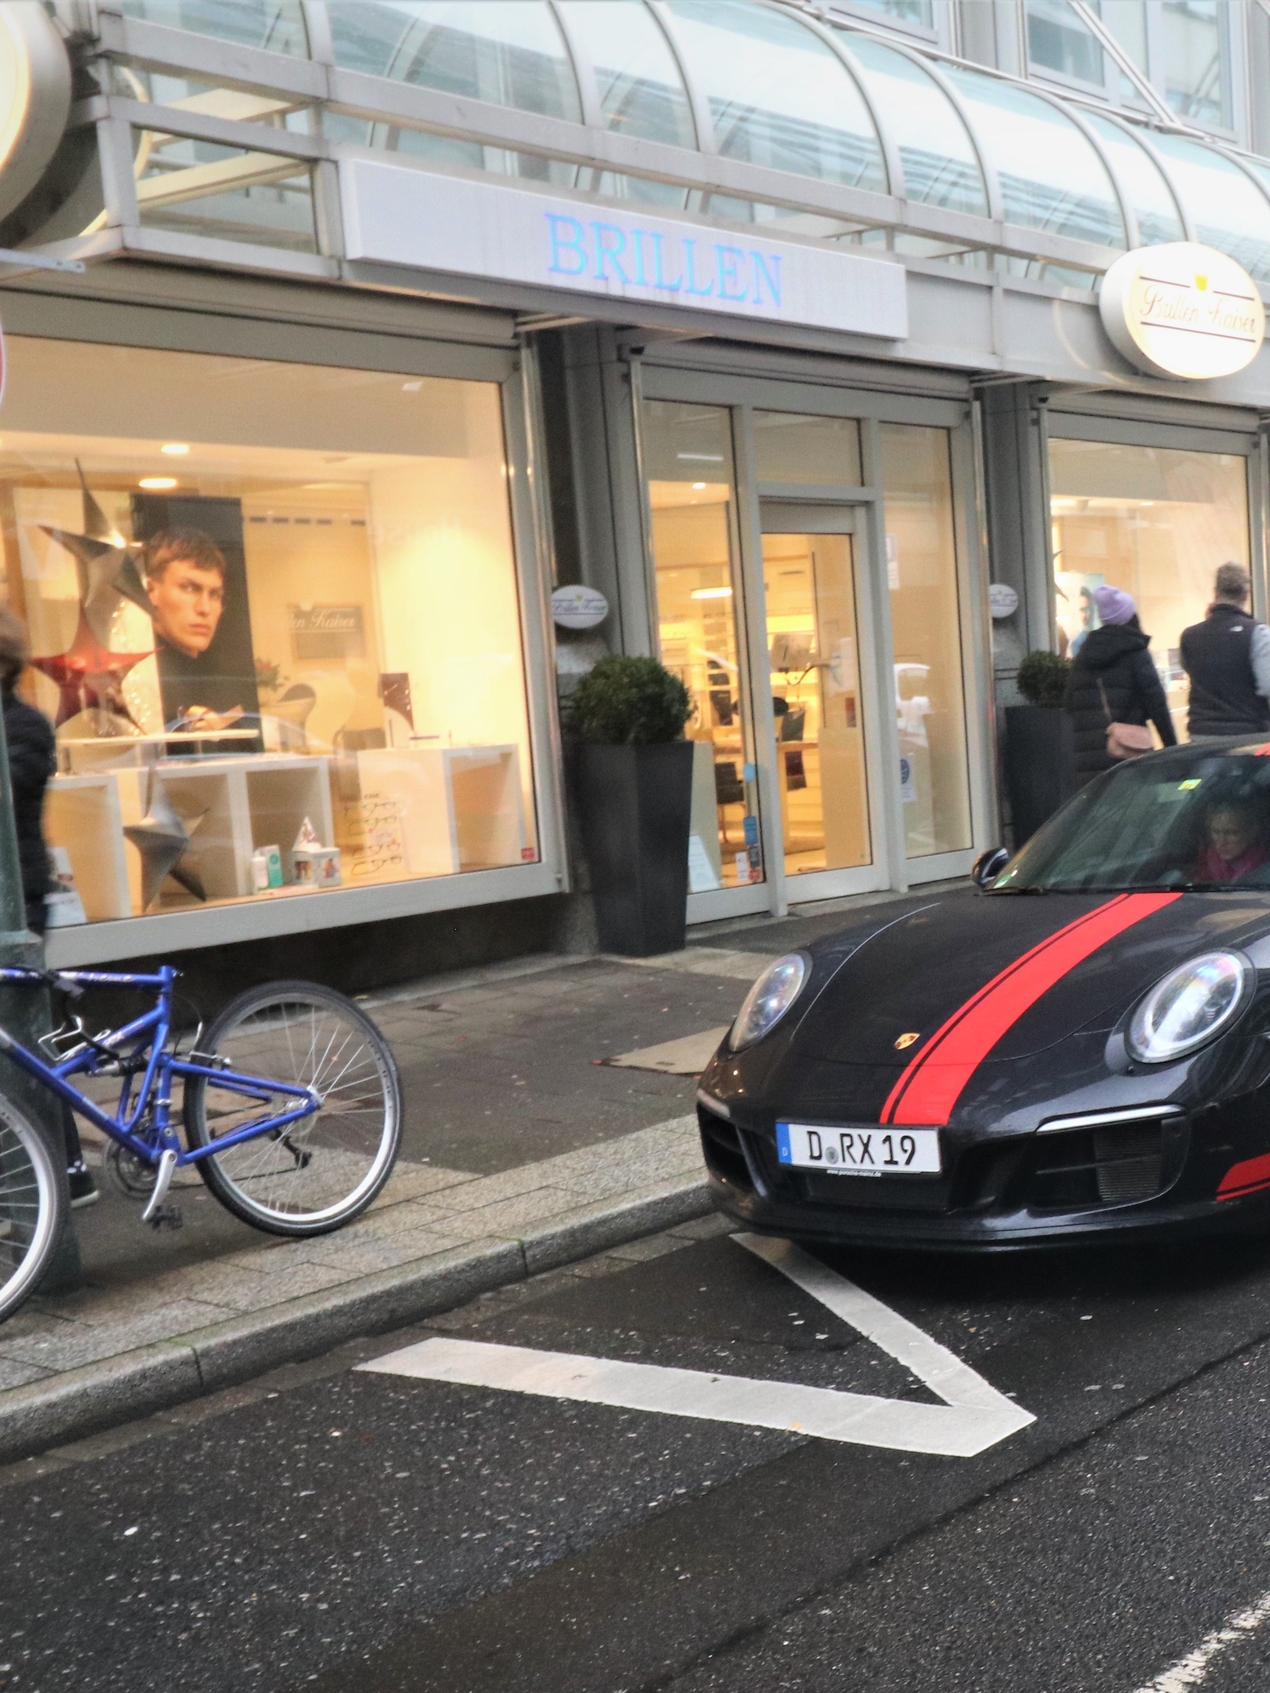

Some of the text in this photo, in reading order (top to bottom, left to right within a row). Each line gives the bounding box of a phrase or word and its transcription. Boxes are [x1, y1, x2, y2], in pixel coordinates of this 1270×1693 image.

[544, 211, 783, 308] BRILLEN
[1140, 285, 1256, 334] Brillen Kaiser
[807, 1130, 916, 1166] D RX 19
